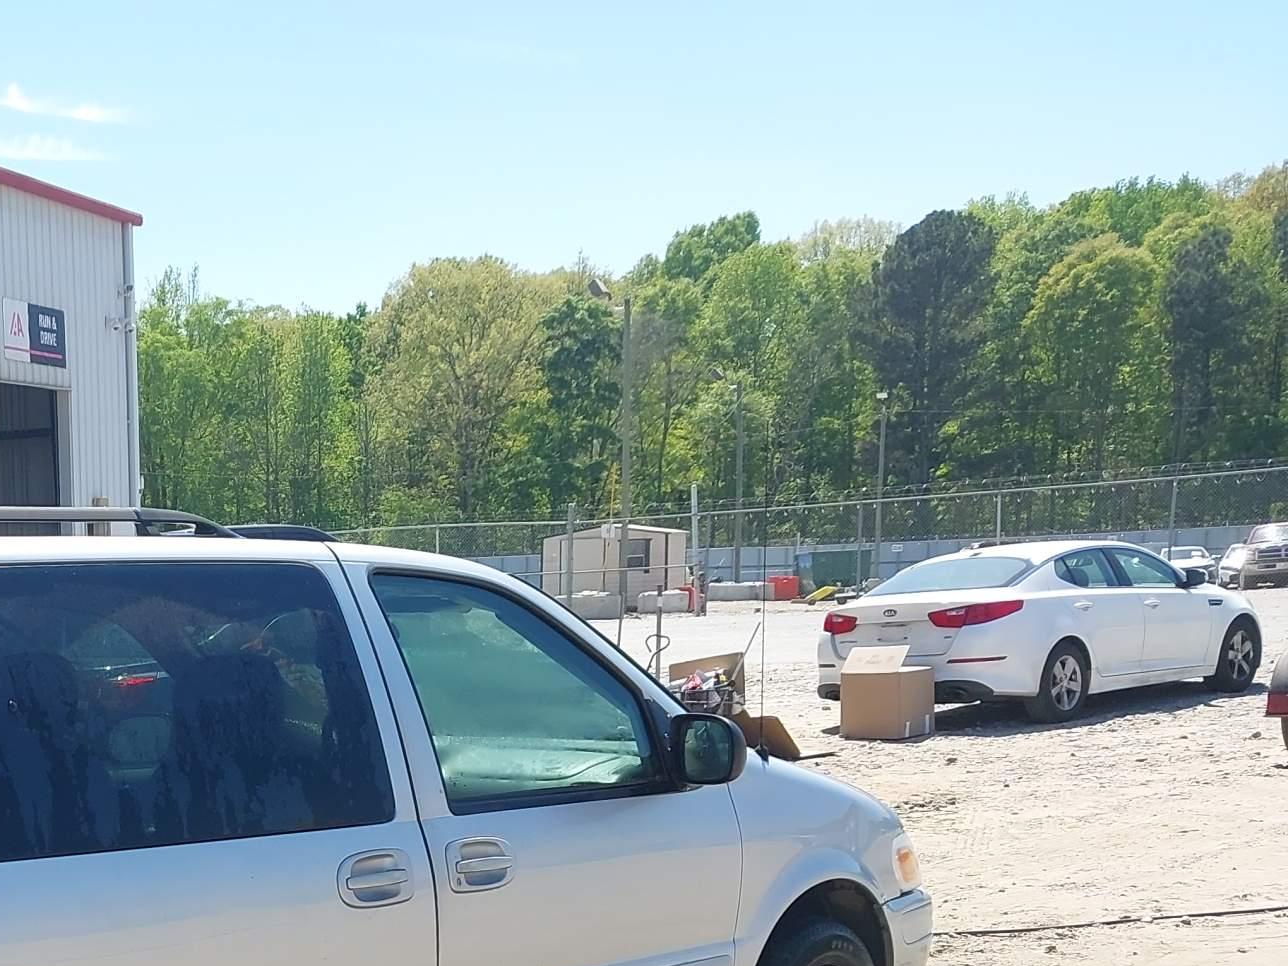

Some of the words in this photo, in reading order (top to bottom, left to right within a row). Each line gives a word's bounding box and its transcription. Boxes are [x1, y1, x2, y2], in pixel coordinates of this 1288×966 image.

[38, 313, 51, 329] RUN
[52, 316, 57, 330] &
[40, 330, 57, 347] DRIVE
